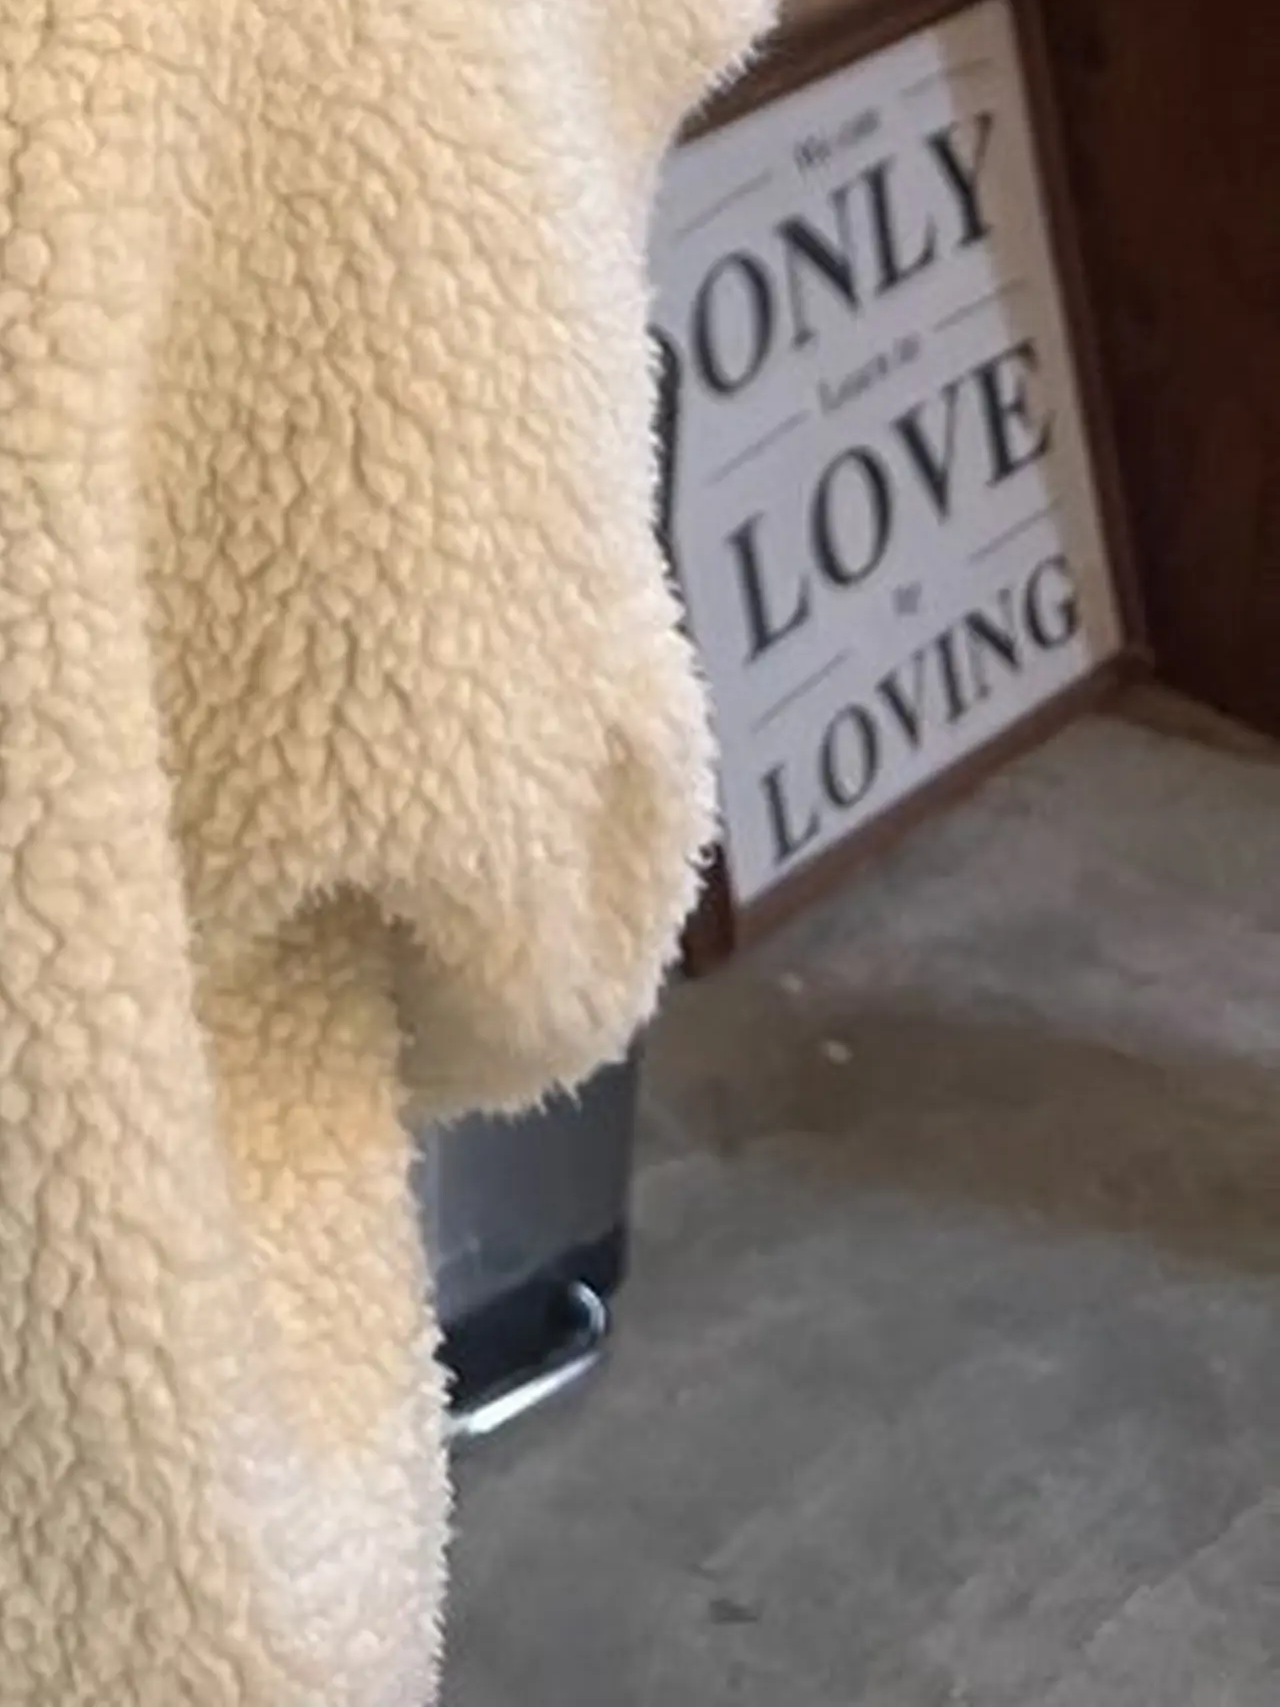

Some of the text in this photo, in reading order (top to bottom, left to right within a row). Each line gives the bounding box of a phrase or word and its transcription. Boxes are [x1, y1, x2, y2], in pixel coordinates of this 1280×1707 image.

[688, 110, 994, 400] ONLY
[725, 338, 1056, 664] LOVE
[760, 554, 1082, 865] LOVING
